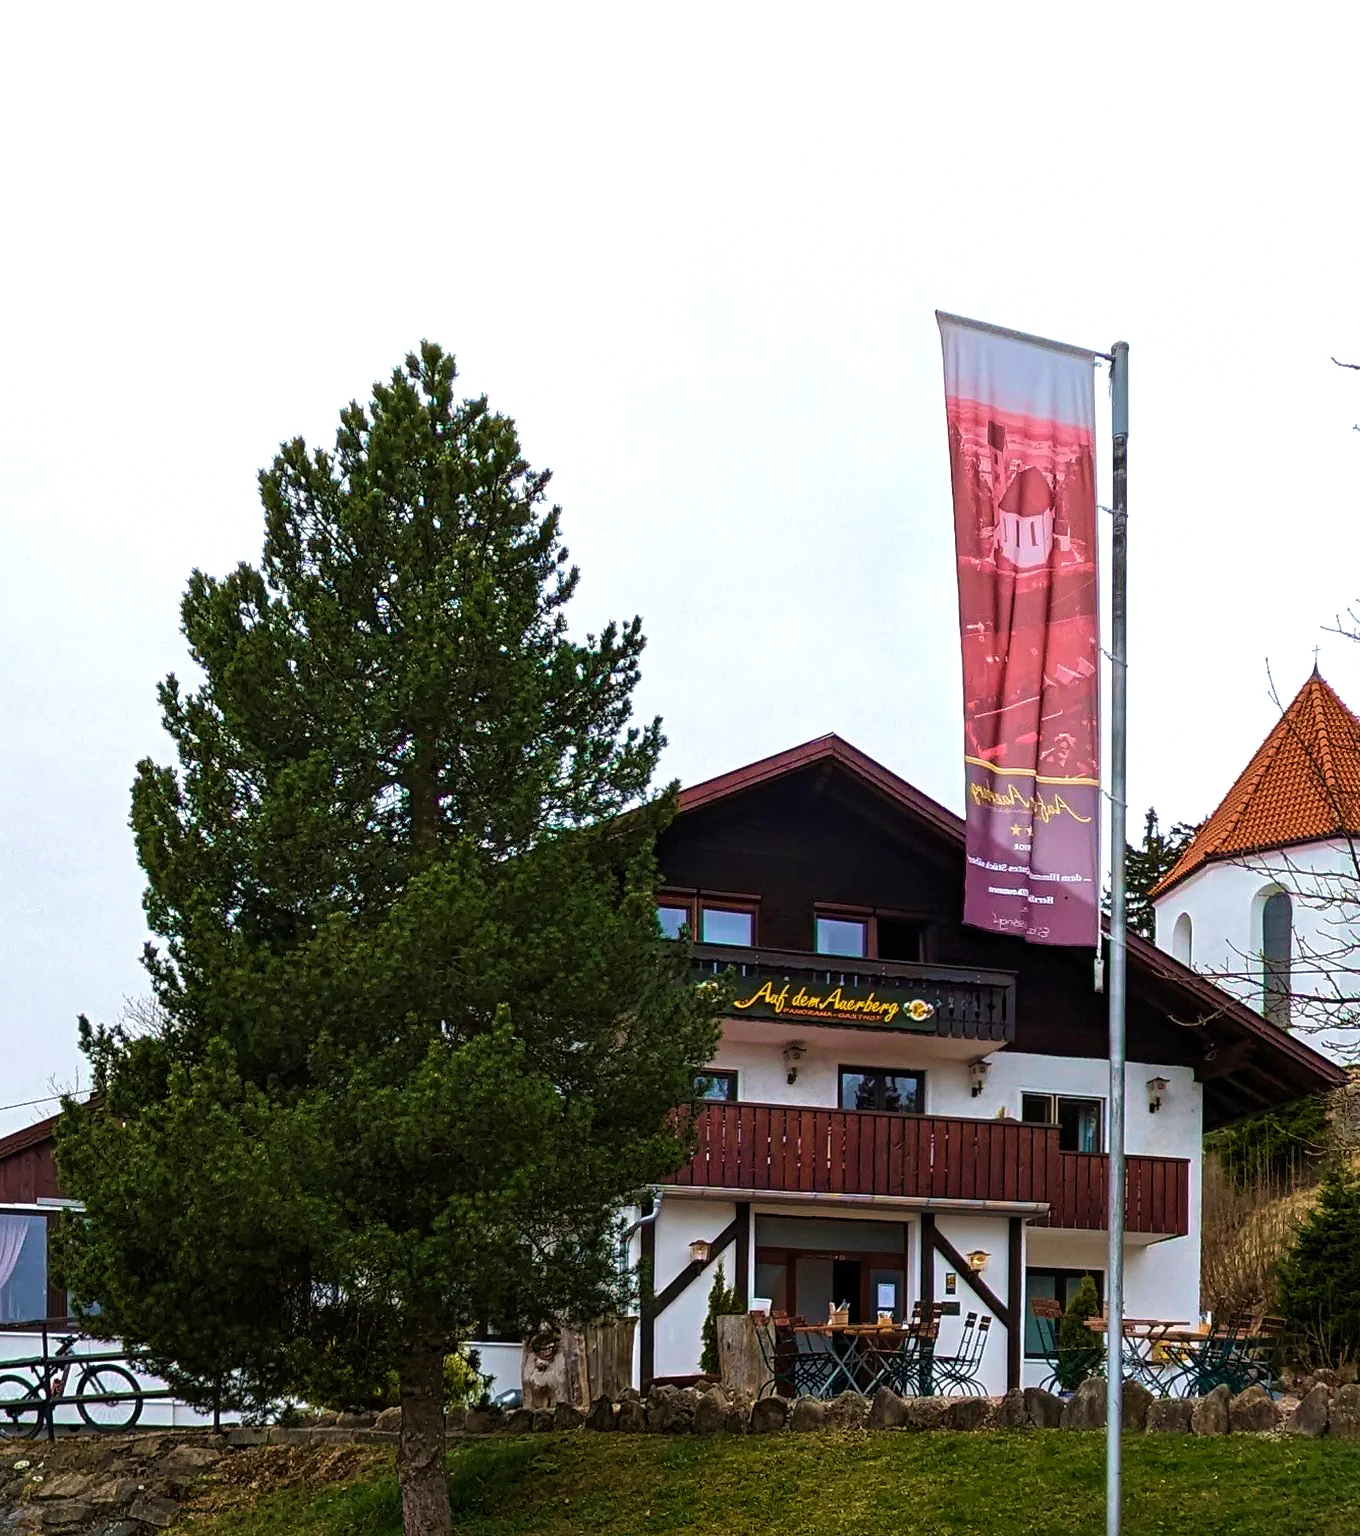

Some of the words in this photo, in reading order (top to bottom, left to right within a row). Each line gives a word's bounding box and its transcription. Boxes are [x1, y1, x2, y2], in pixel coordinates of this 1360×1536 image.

[734, 981, 790, 1013] Auf
[792, 986, 820, 1008] dem
[819, 988, 899, 1022] Auerberg
